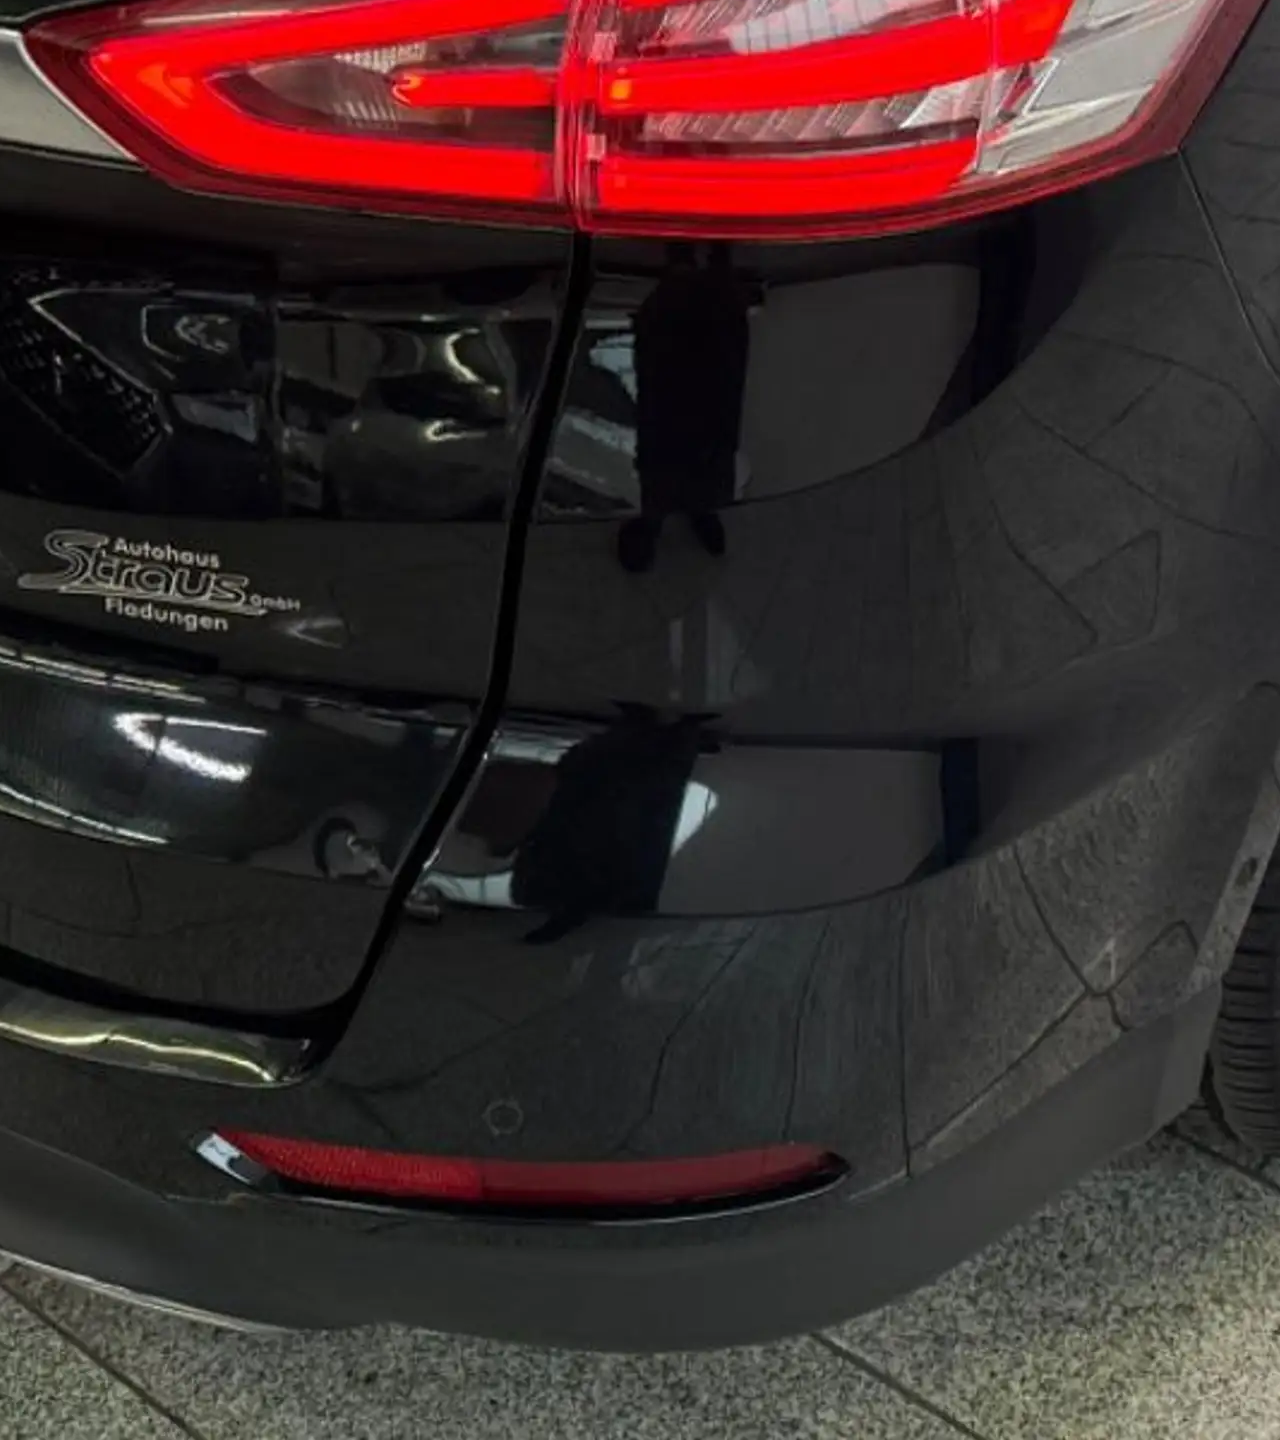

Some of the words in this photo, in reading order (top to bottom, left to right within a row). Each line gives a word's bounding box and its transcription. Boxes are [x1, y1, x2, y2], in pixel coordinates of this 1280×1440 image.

[114, 537, 221, 568] Autohaus
[18, 529, 266, 615] Straus
[104, 596, 229, 633] Fladungen
